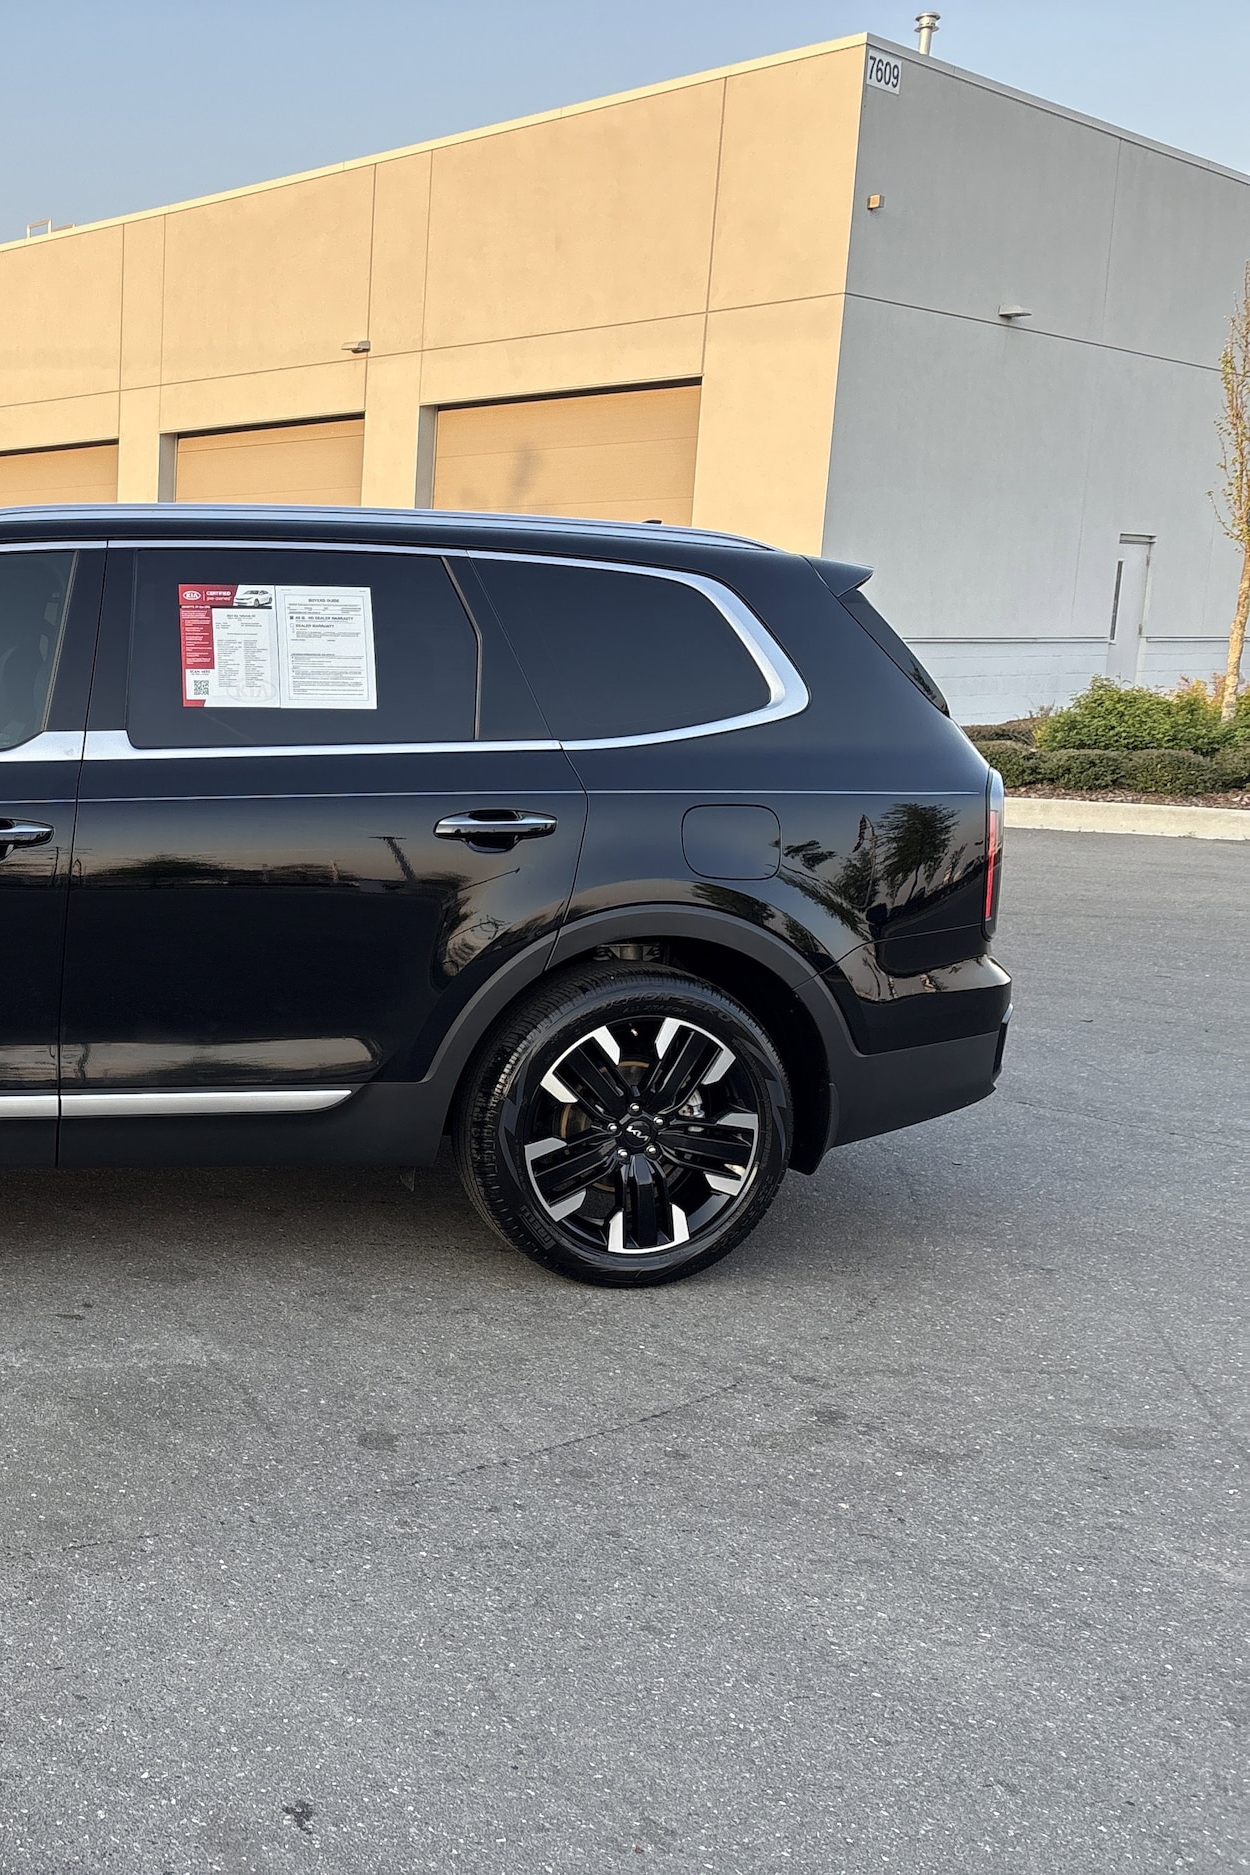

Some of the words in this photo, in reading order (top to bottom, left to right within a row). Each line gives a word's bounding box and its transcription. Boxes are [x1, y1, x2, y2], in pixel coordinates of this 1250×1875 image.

[869, 55, 900, 88] 7609
[184, 592, 200, 600] KIA
[518, 1205, 557, 1251] PIRELLI
